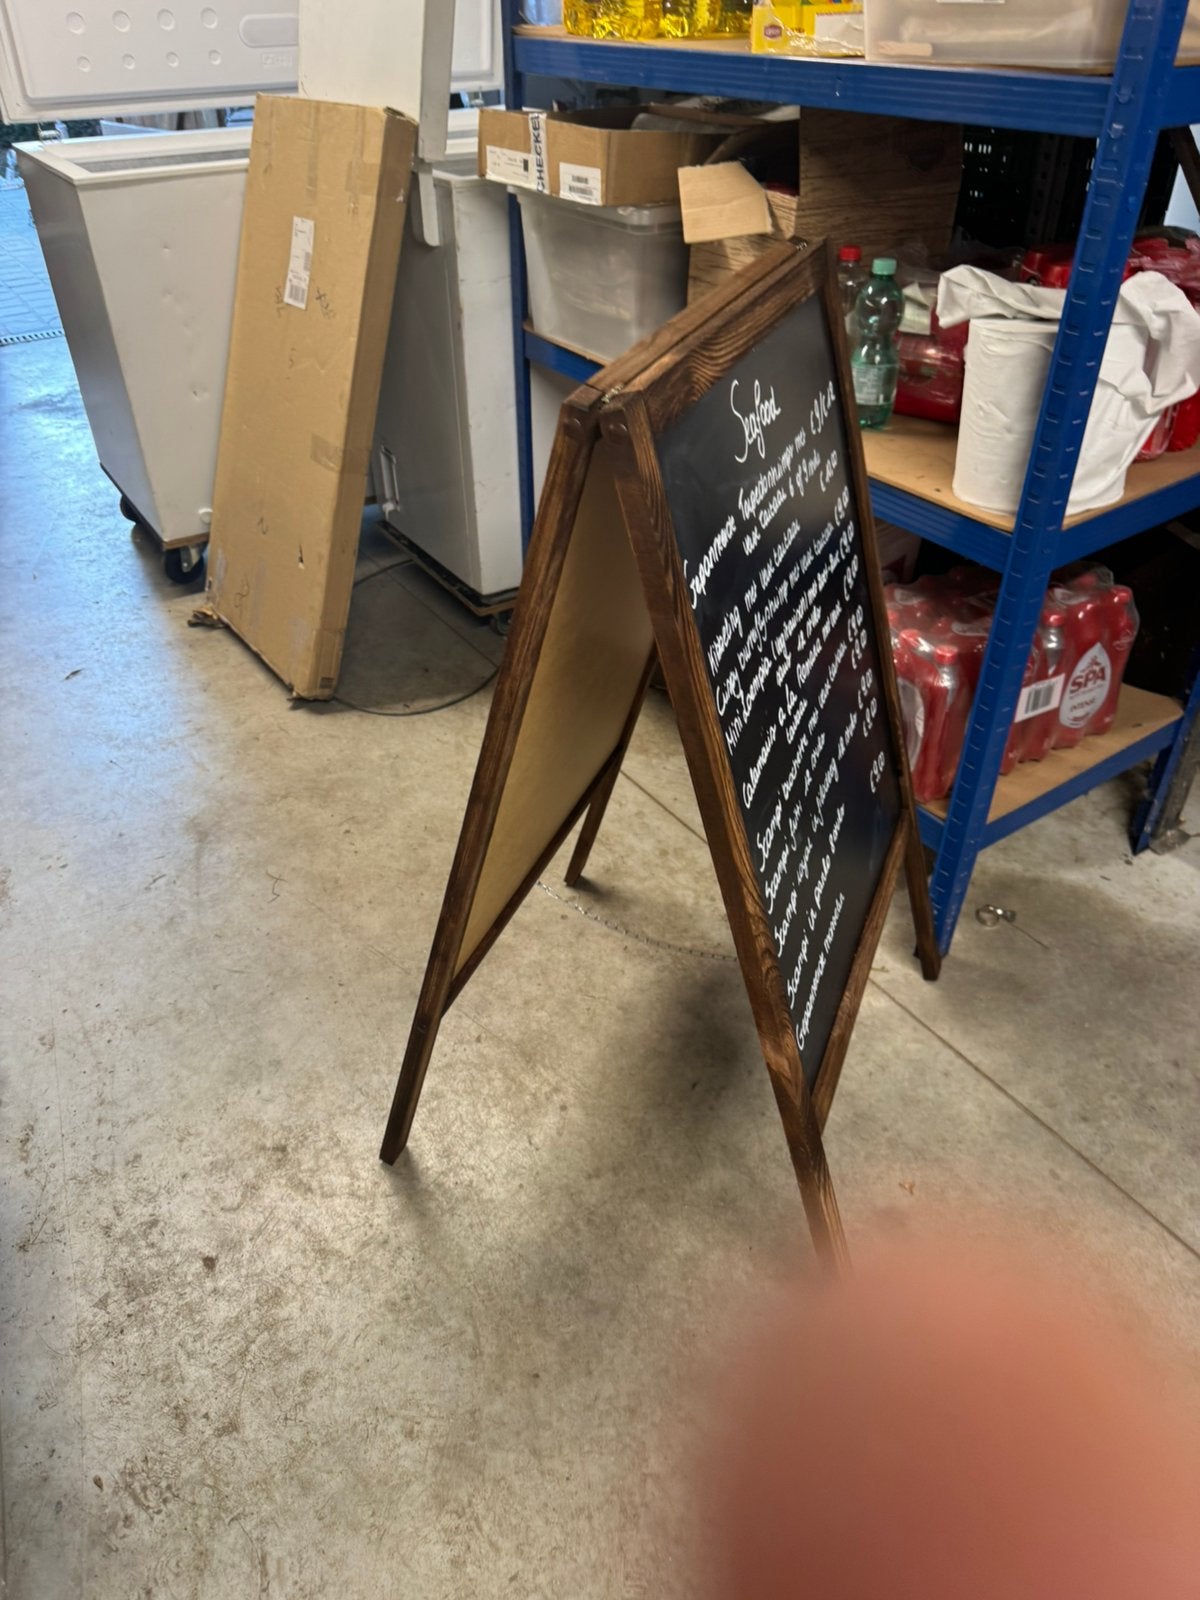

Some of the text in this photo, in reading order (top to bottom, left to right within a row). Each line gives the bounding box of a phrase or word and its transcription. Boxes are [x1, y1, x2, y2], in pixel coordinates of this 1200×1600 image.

[730, 379, 781, 463] Seafood
[707, 606, 743, 677] Kibbeling
[1069, 666, 1106, 694] SPA
[725, 709, 743, 756] Mini
[757, 791, 782, 873] Scampi
[765, 836, 789, 915] Scampi
[774, 883, 797, 958] Scampi
[787, 929, 809, 1010] Scampi
